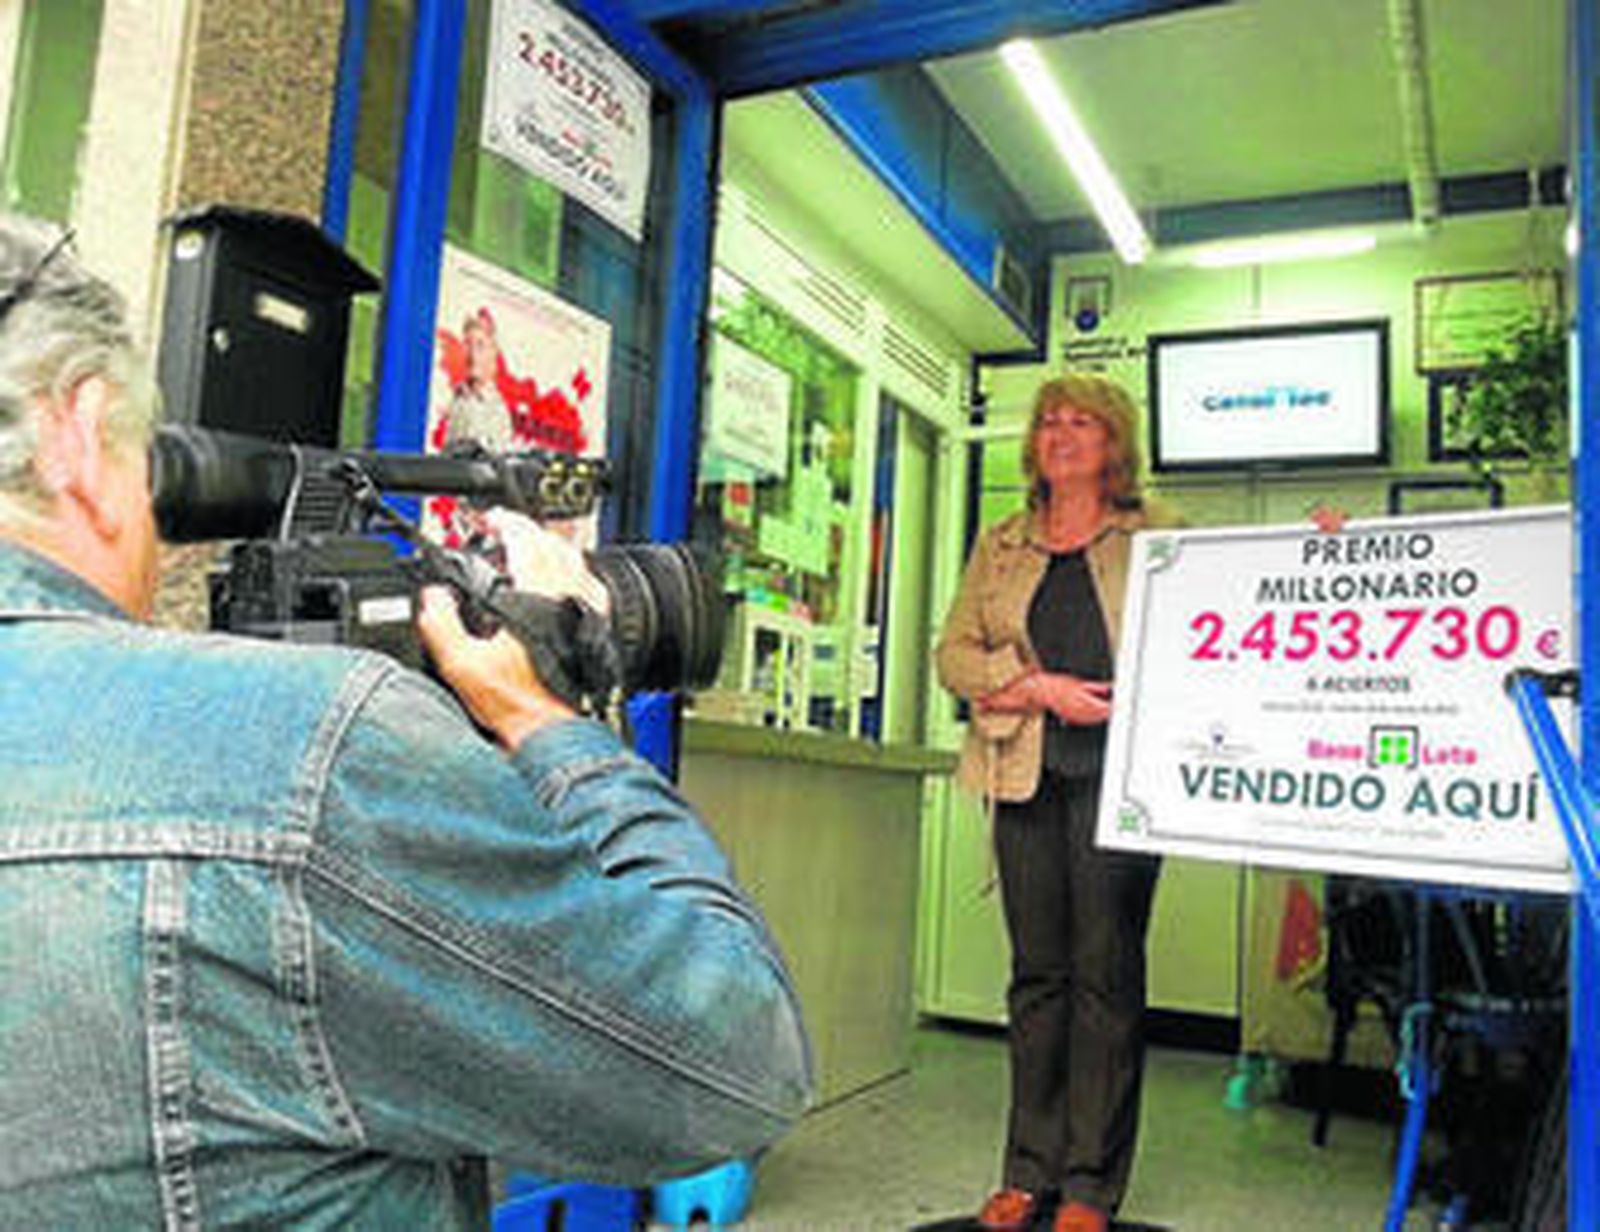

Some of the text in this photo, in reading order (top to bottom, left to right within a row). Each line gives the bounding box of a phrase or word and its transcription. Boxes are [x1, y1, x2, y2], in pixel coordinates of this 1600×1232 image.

[1302, 533, 1435, 565] PREMIO
[1256, 568, 1479, 603] MILLONARIO
[1189, 605, 1561, 661] 2.453.730 €
[1179, 763, 1539, 822] VENDIDO AQUÍ
